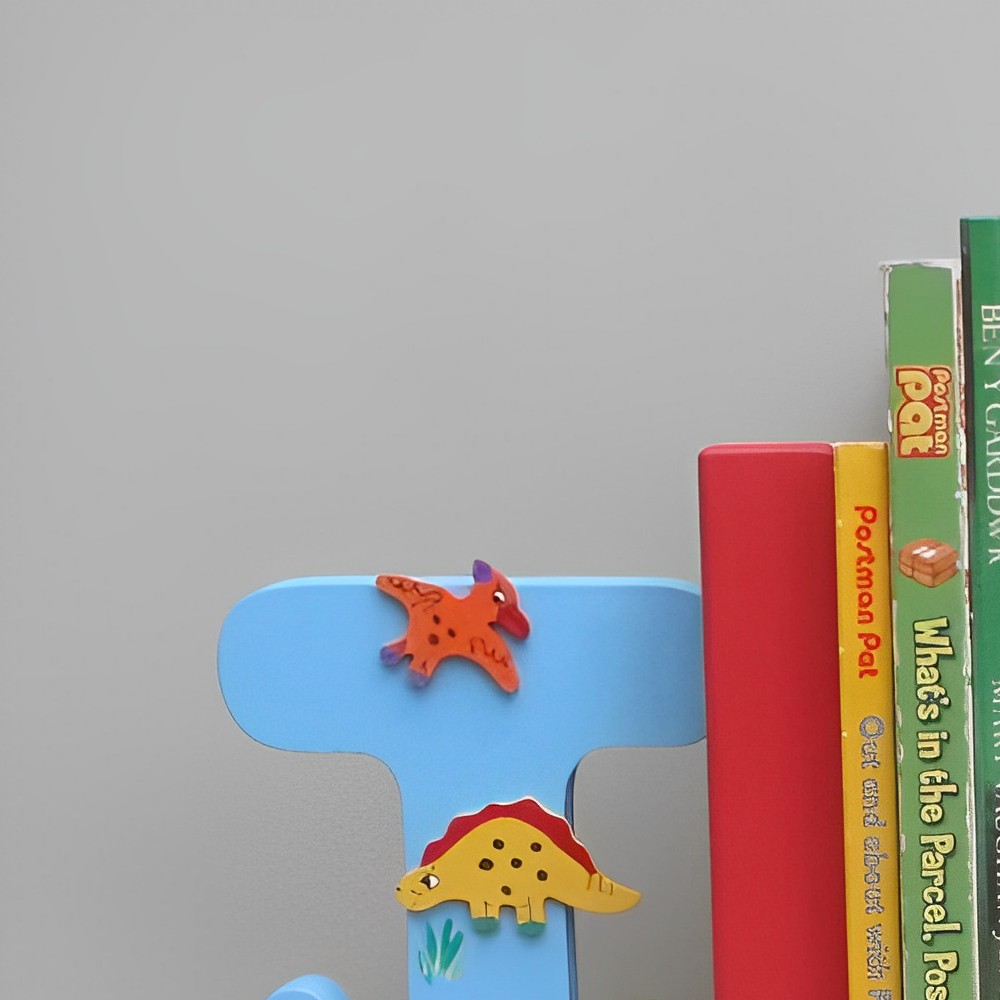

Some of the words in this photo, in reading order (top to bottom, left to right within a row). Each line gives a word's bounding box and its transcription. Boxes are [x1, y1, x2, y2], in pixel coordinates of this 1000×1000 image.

[854, 505, 878, 625] Postman
[858, 633, 881, 678] Pat
[916, 731, 949, 760] in
[917, 769, 960, 824] the
